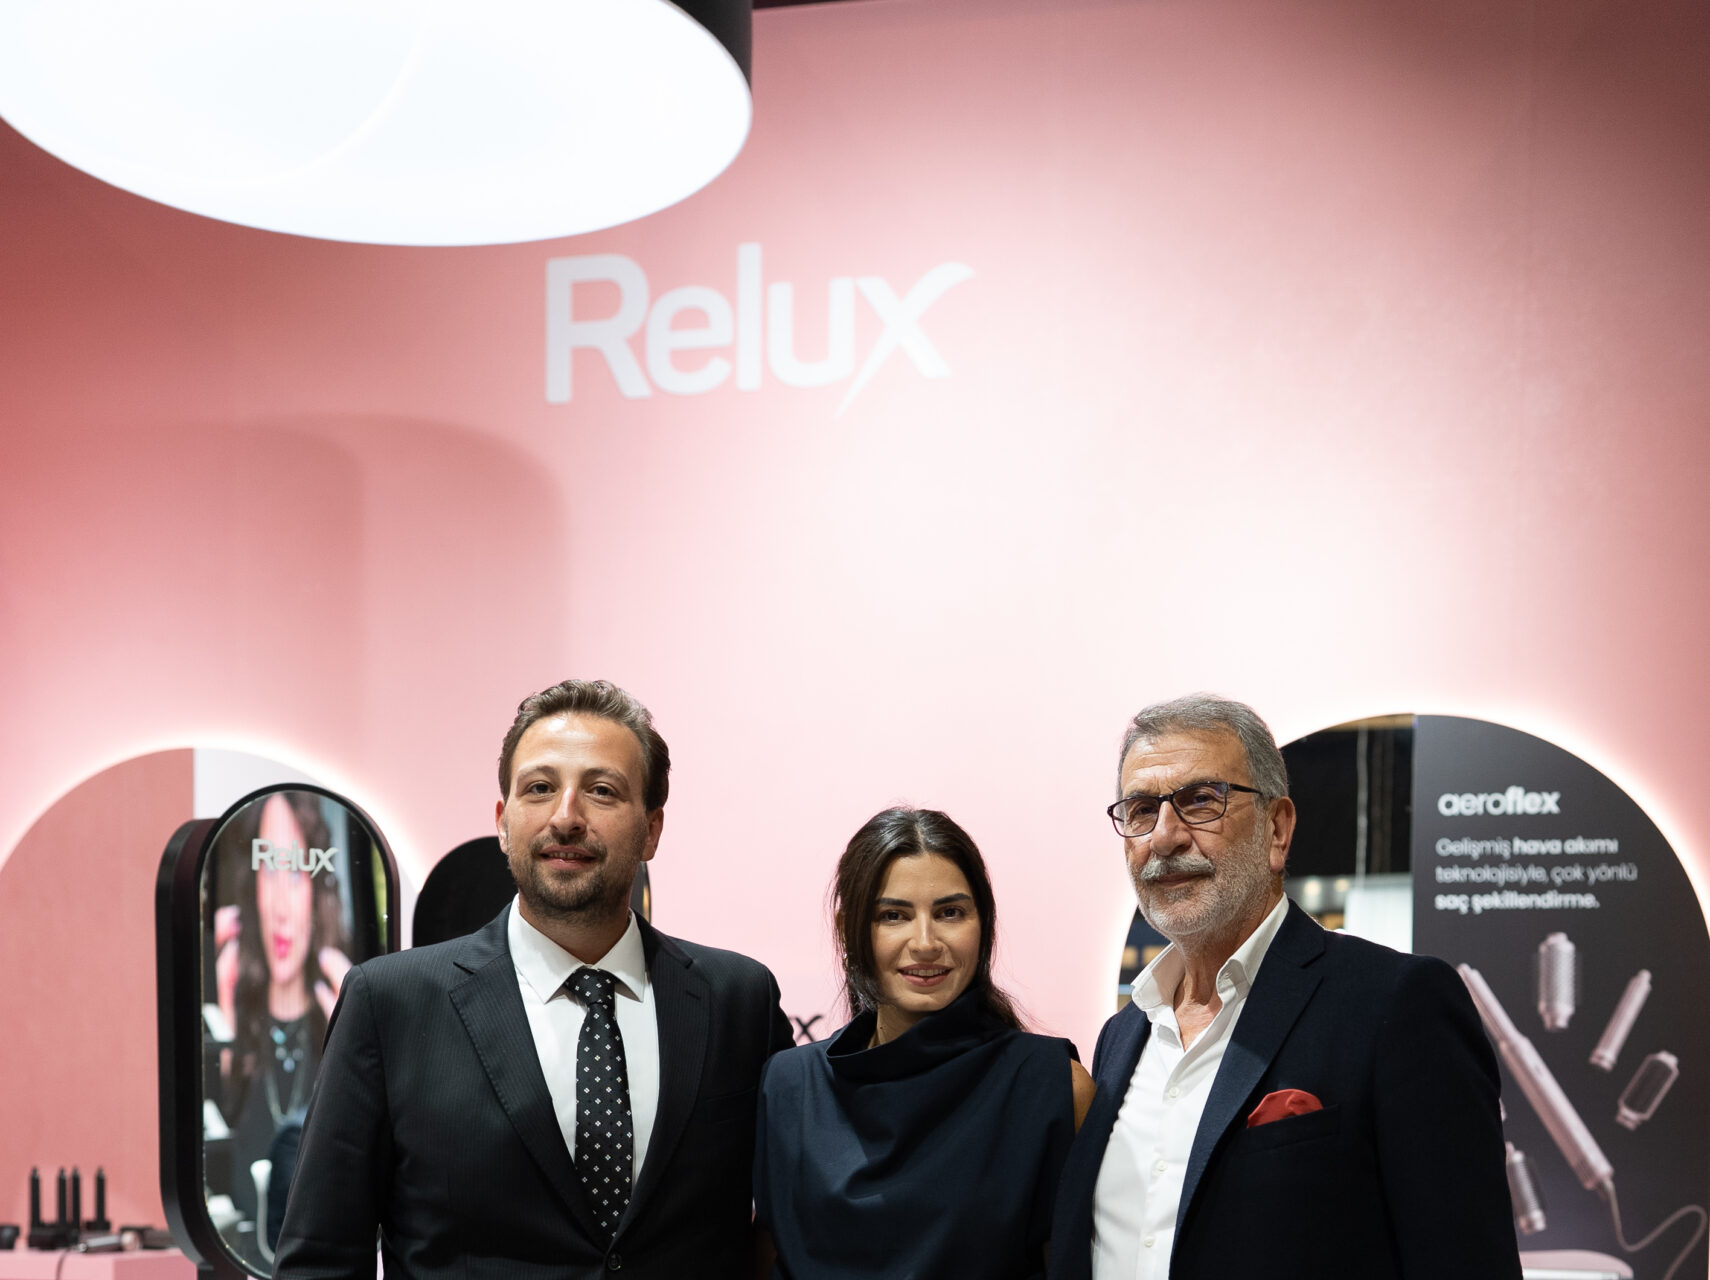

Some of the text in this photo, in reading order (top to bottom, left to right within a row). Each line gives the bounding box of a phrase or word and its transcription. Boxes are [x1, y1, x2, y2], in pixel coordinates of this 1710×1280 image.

[545, 242, 976, 421] Relux
[1437, 785, 1561, 816] aeroflex
[251, 838, 339, 879] Relux
[1512, 836, 1562, 855] hava
[1550, 863, 1585, 887] çok
[1434, 893, 1470, 915] saç
